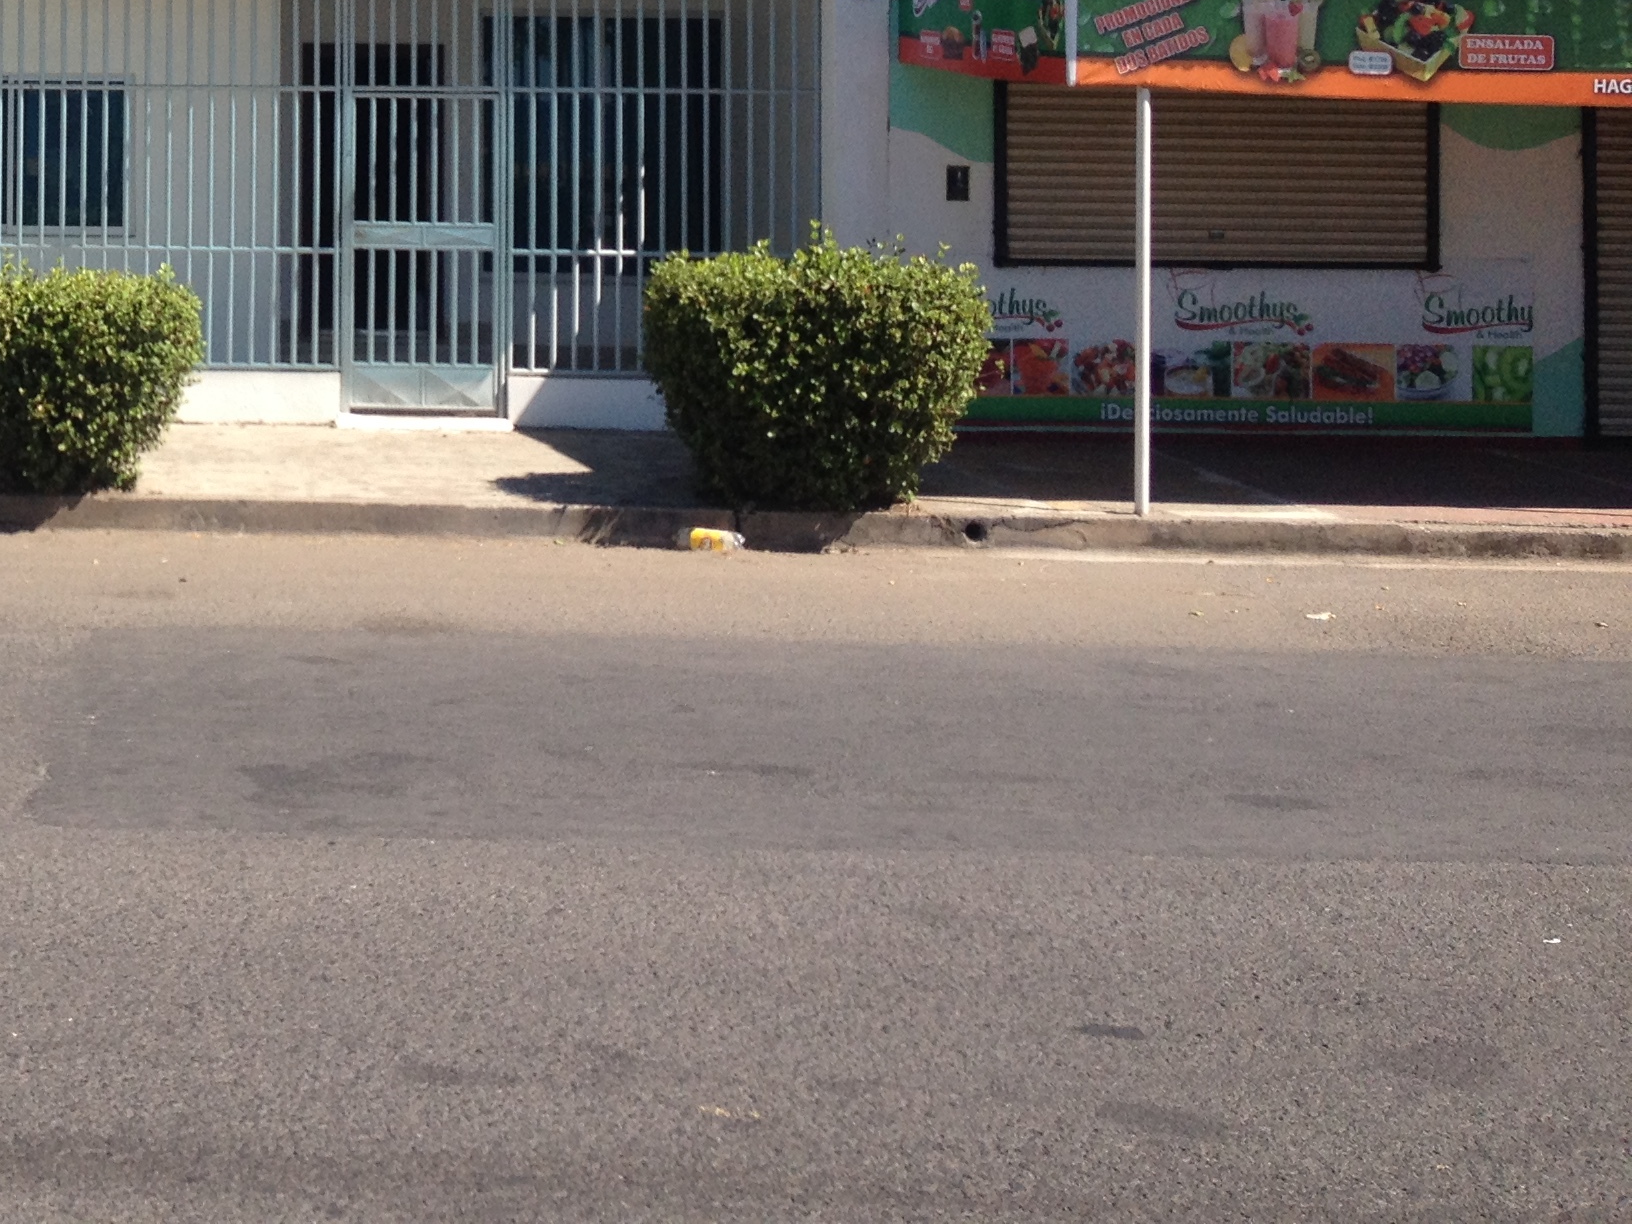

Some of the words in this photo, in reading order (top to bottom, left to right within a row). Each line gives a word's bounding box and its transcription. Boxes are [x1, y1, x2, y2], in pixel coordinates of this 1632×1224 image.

[1121, 26, 1145, 48] EN
[1141, 12, 1185, 41] CADA
[1114, 49, 1148, 75] DOS
[1146, 26, 1209, 64] BATIDOS
[1466, 38, 1544, 50] ENSALADA
[1466, 53, 1487, 64] DE
[1489, 54, 1546, 65] FRUTAS
[1174, 288, 1299, 329] Smoothys
[1265, 405, 1374, 424] Saludable!
